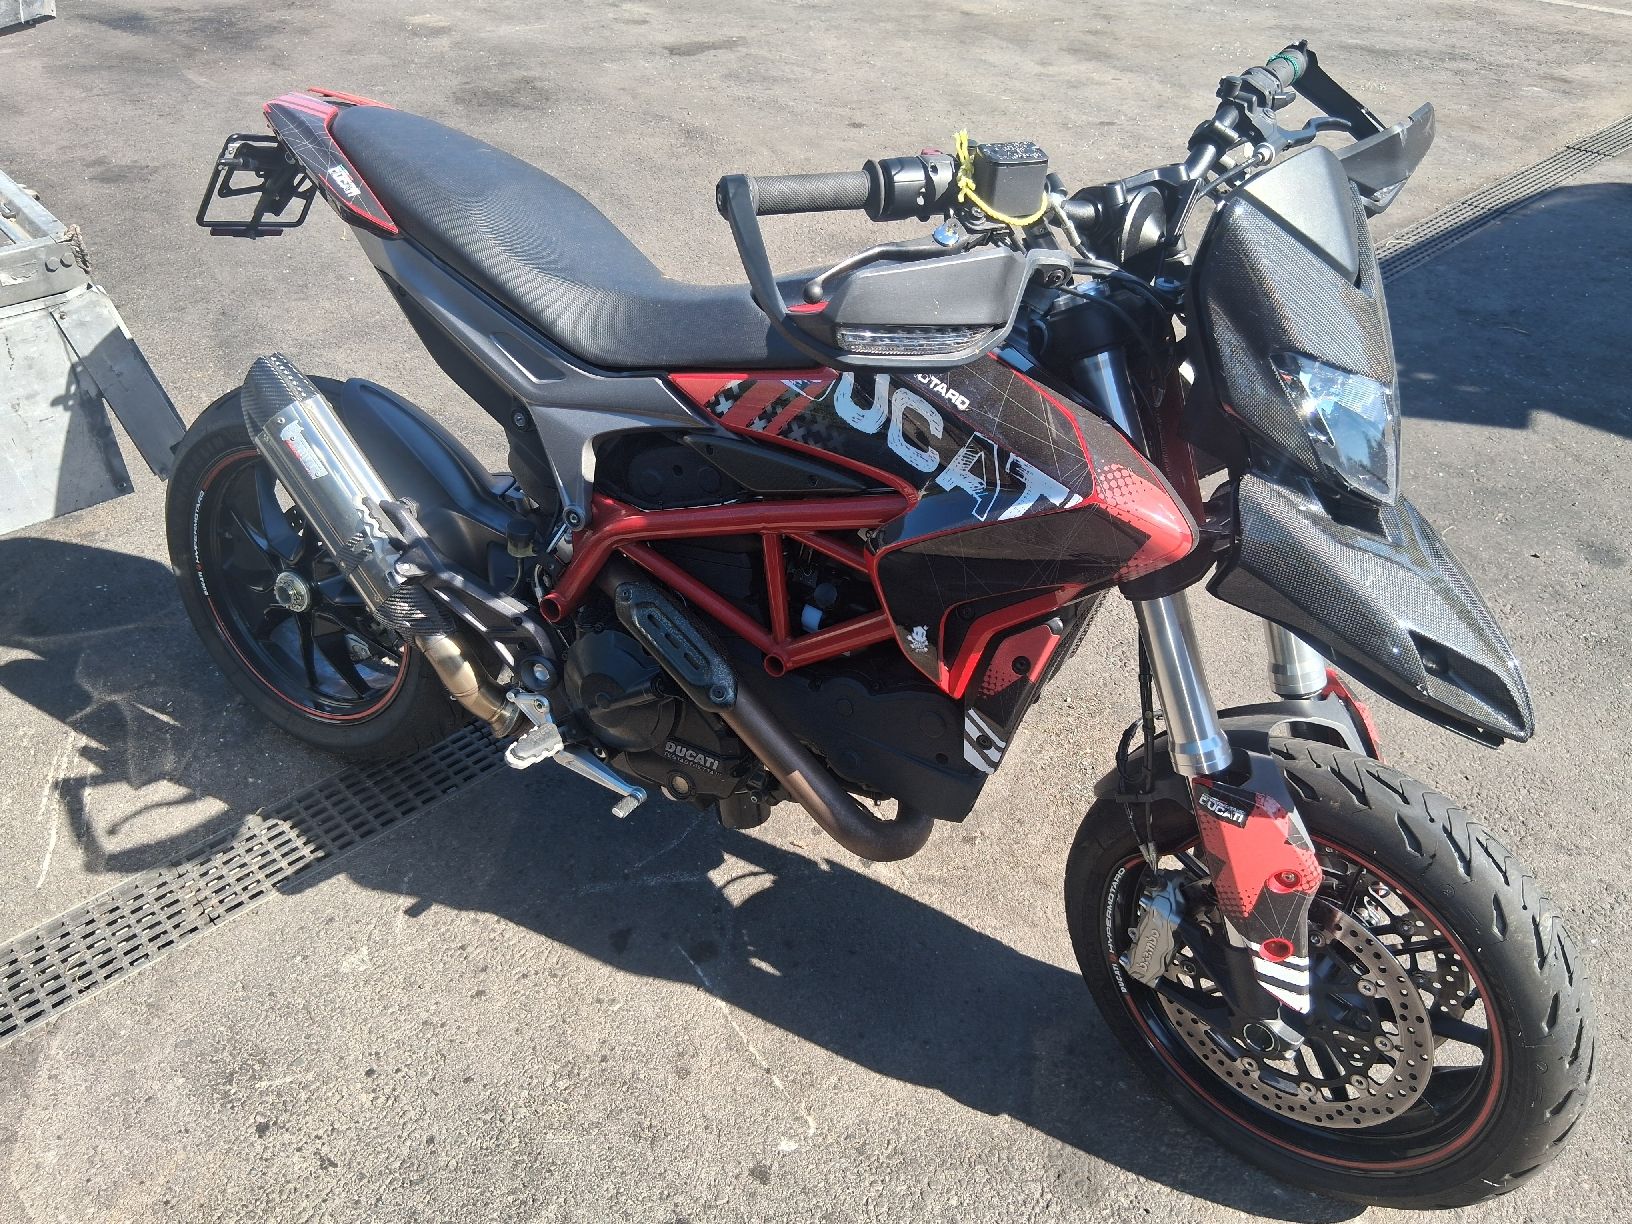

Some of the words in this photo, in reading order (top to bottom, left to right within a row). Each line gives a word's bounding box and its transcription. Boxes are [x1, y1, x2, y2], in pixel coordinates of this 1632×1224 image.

[914, 373, 970, 410] OTARD
[193, 490, 204, 563] HYPERMOTARD
[198, 572, 209, 595] DUCATI
[665, 741, 719, 770] DUCATI
[1105, 867, 1125, 953] HYPERMOTARD
[1136, 929, 1160, 973] brembo
[1112, 964, 1128, 993] DUCATI
